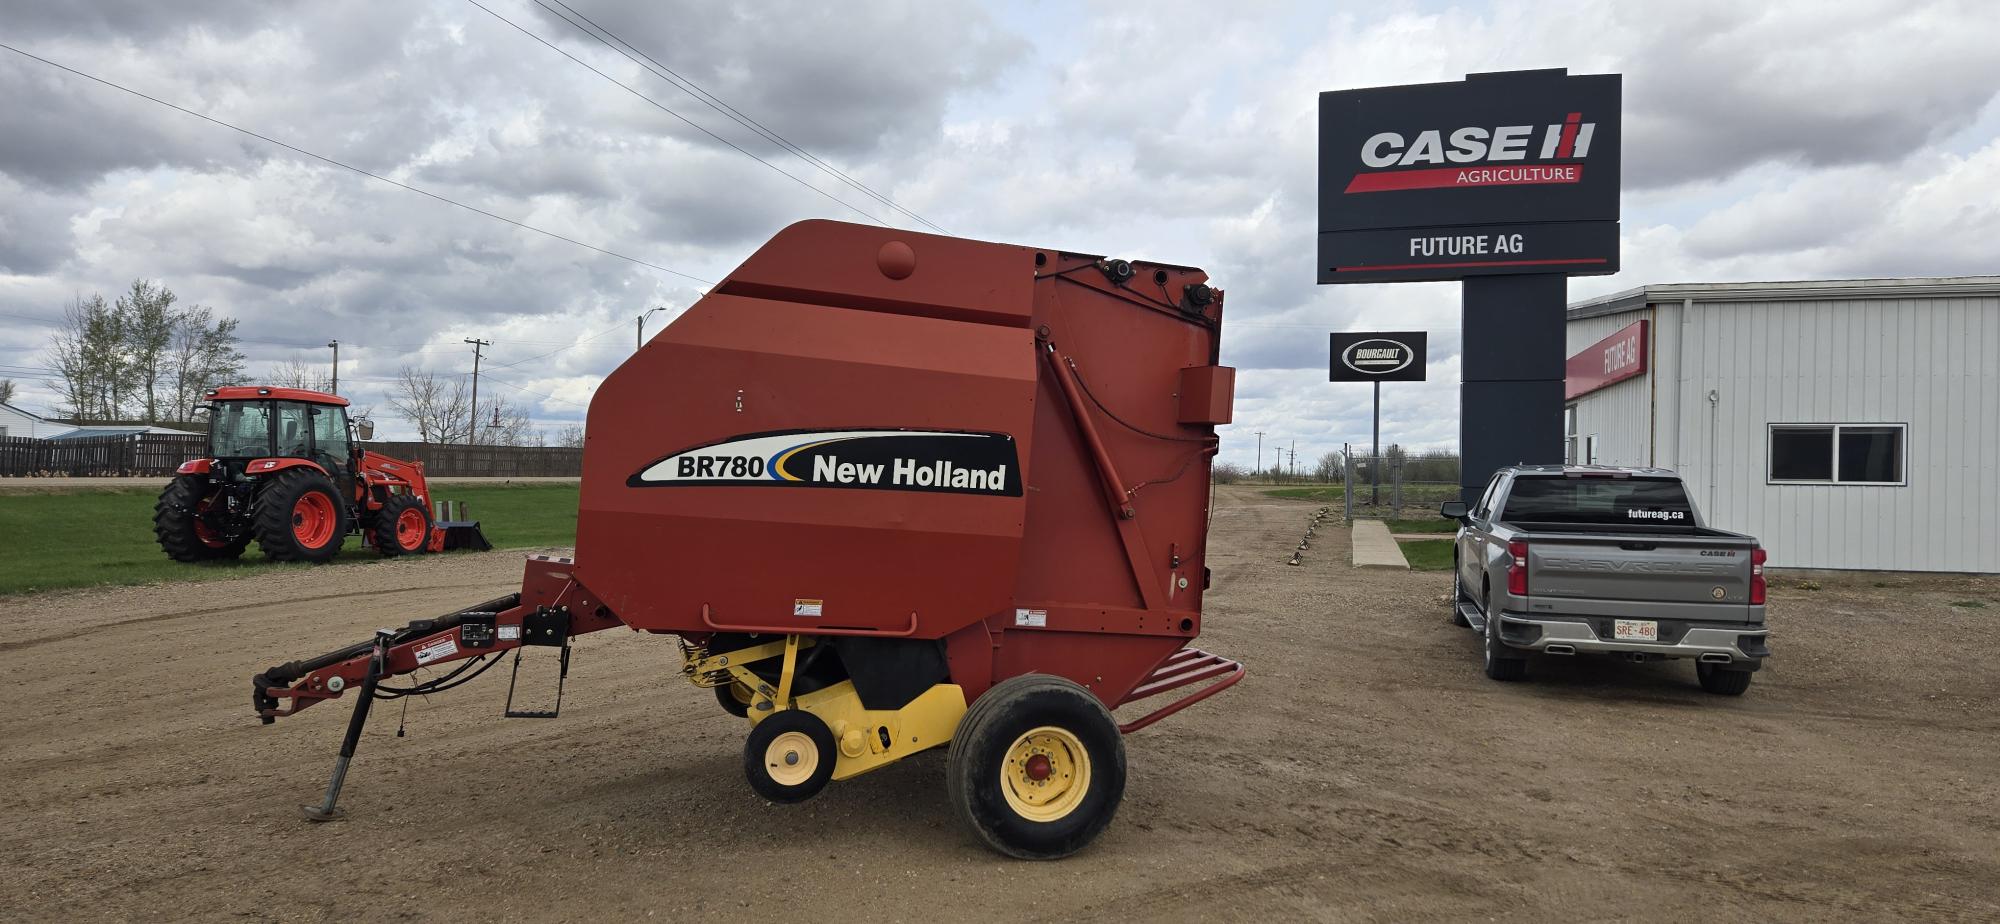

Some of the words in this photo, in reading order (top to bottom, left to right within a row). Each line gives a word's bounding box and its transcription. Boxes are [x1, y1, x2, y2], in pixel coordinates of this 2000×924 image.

[1361, 125, 1533, 168] CASE
[1456, 167, 1574, 184] AGRICULTURE
[1410, 235, 1488, 257] FUTURE
[1494, 233, 1523, 254] AG
[1356, 348, 1400, 359] BOURGAULT
[1604, 340, 1626, 375] FUTURE
[1626, 335, 1636, 366] AG
[677, 455, 765, 478] BR780
[812, 454, 885, 484] New
[892, 457, 1006, 491] Holland
[1628, 509, 1684, 520] futureag.ca
[1543, 557, 1736, 575] CHEVROLET
